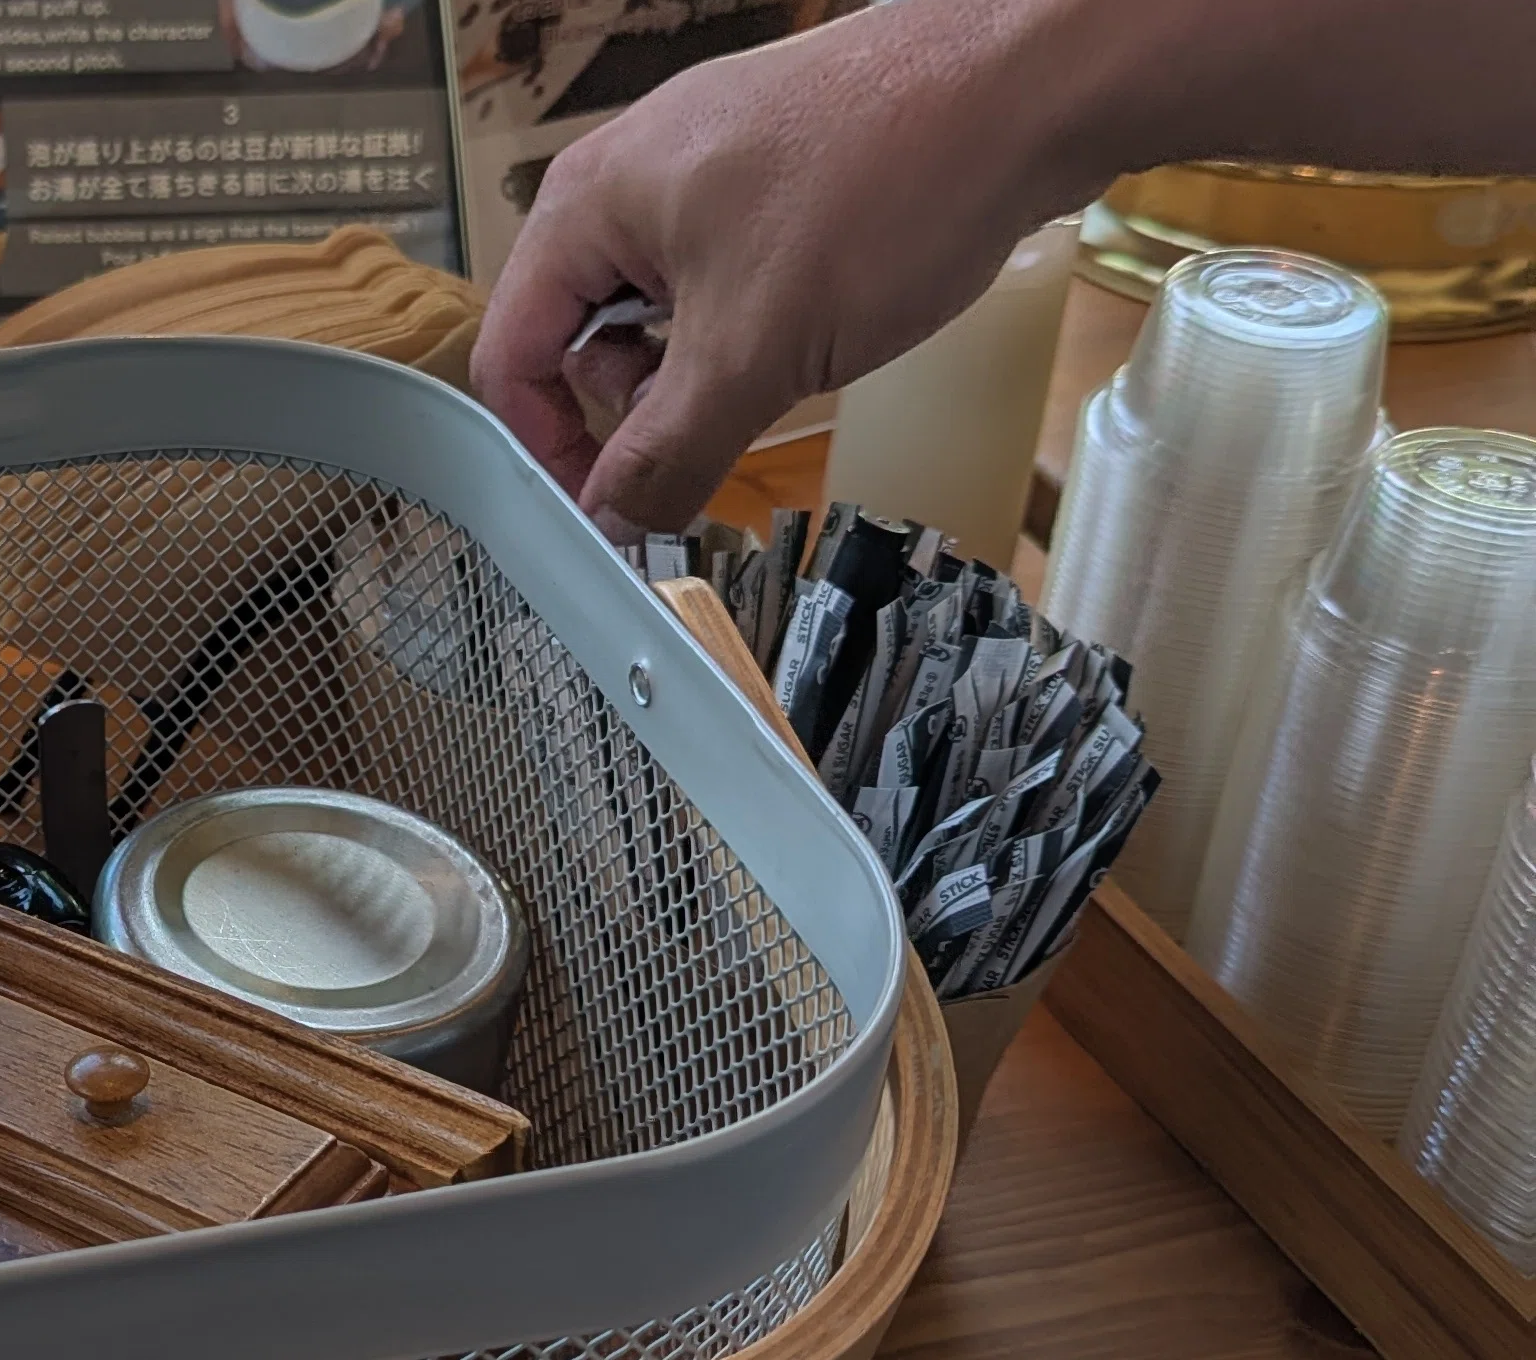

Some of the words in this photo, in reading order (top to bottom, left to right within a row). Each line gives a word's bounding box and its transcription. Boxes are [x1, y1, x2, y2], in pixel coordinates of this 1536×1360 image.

[222, 103, 241, 126] 3
[779, 658, 801, 714] SUGAR
[796, 598, 813, 645] STICK
[830, 721, 855, 769] SUGAR
[1066, 752, 1098, 793] STICK
[938, 870, 984, 905] STICK
